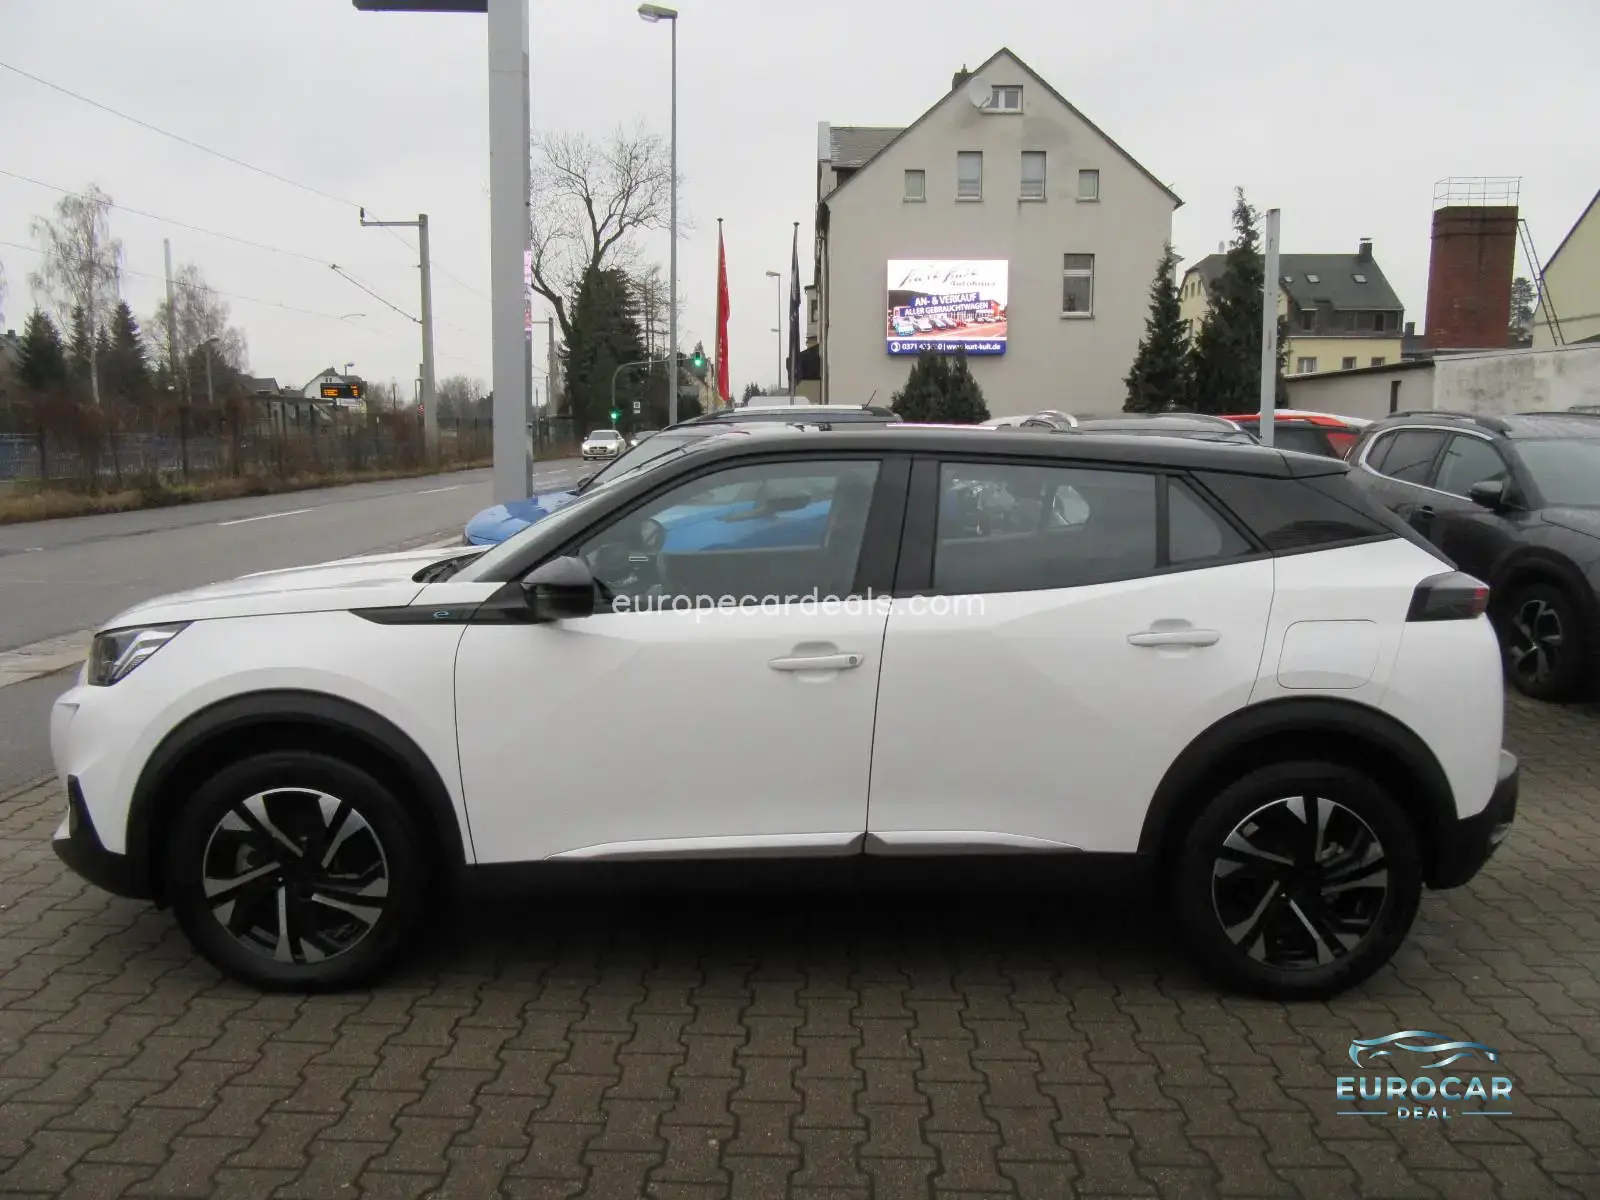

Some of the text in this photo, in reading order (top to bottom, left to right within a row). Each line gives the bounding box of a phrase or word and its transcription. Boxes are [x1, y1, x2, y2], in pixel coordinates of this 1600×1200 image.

[914, 292, 977, 307] AN- & VERKAUF
[904, 306, 925, 316] ALLER
[925, 301, 989, 314] GEBRAUCHTWAGEN
